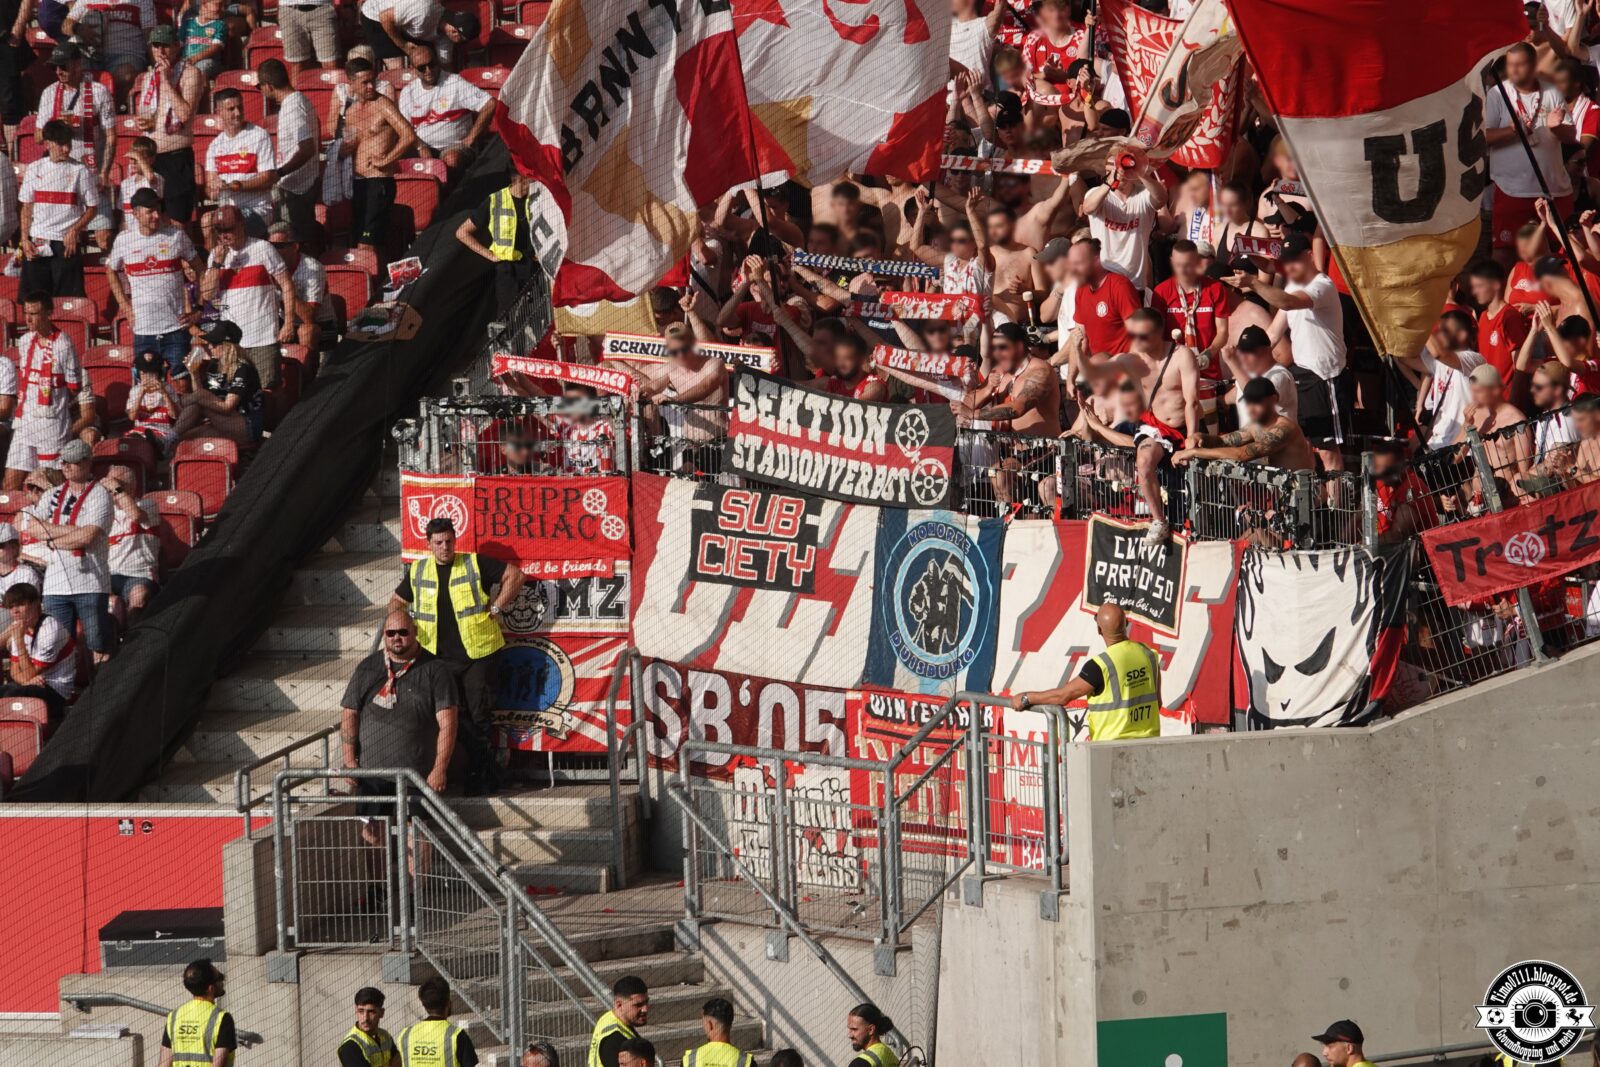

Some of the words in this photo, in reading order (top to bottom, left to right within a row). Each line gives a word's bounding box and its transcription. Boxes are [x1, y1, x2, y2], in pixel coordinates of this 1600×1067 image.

[506, 358, 563, 376] GRUPPO
[568, 364, 626, 388] UBRIACO
[889, 347, 950, 374] ULTRAS
[735, 372, 892, 456] SEKTION
[731, 432, 911, 503] STADIONVERBOT
[544, 561, 559, 574] be
[562, 558, 607, 575] friends
[697, 532, 816, 587] CIETY
[554, 573, 627, 619] MZ
[1126, 666, 1147, 681] SDS
[870, 693, 994, 728] WINTEHR
[1129, 704, 1152, 723] 1077
[178, 1024, 200, 1035] SDS
[413, 1045, 438, 1056] SDS
